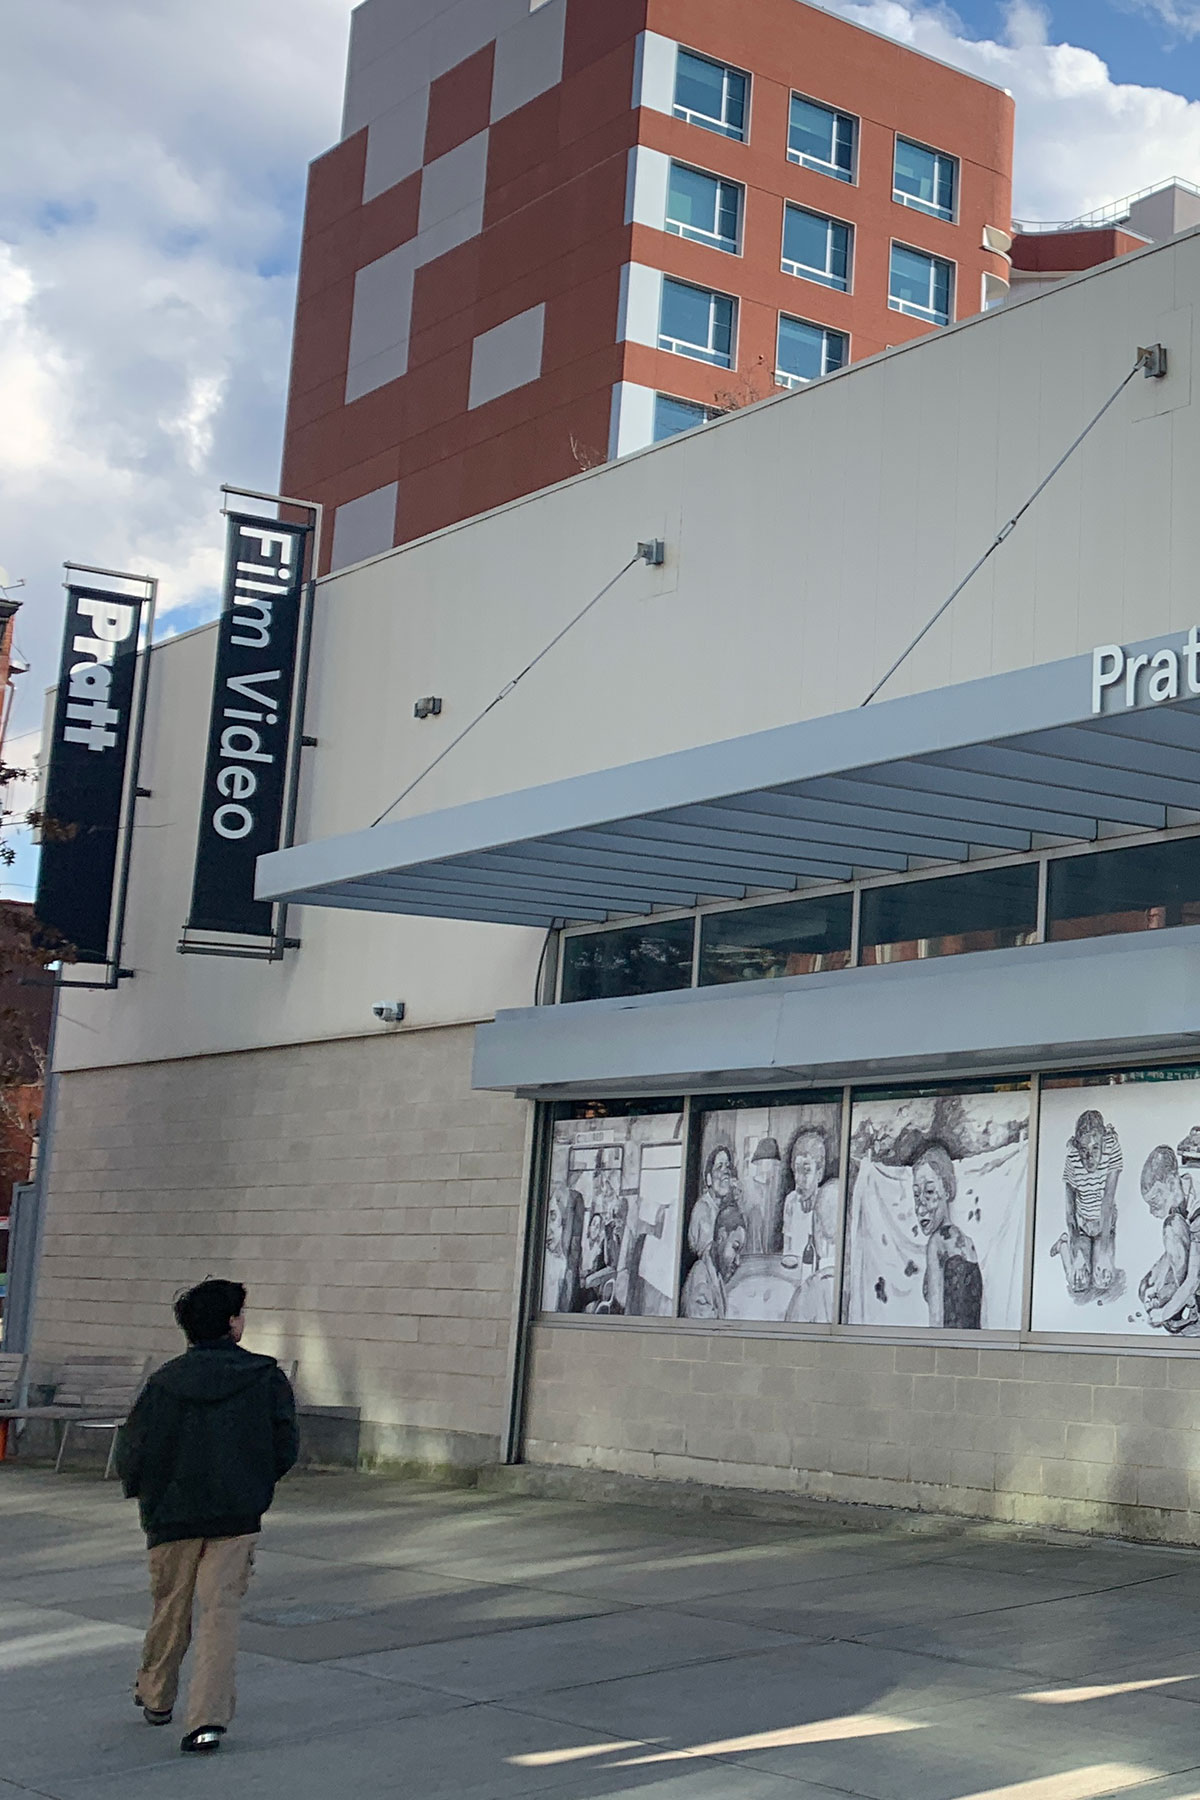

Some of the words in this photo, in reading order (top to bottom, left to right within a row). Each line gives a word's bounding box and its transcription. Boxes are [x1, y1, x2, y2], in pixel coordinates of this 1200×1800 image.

[230, 526, 292, 650] Film
[63, 597, 133, 752] Pratt
[212, 669, 282, 840] Video
